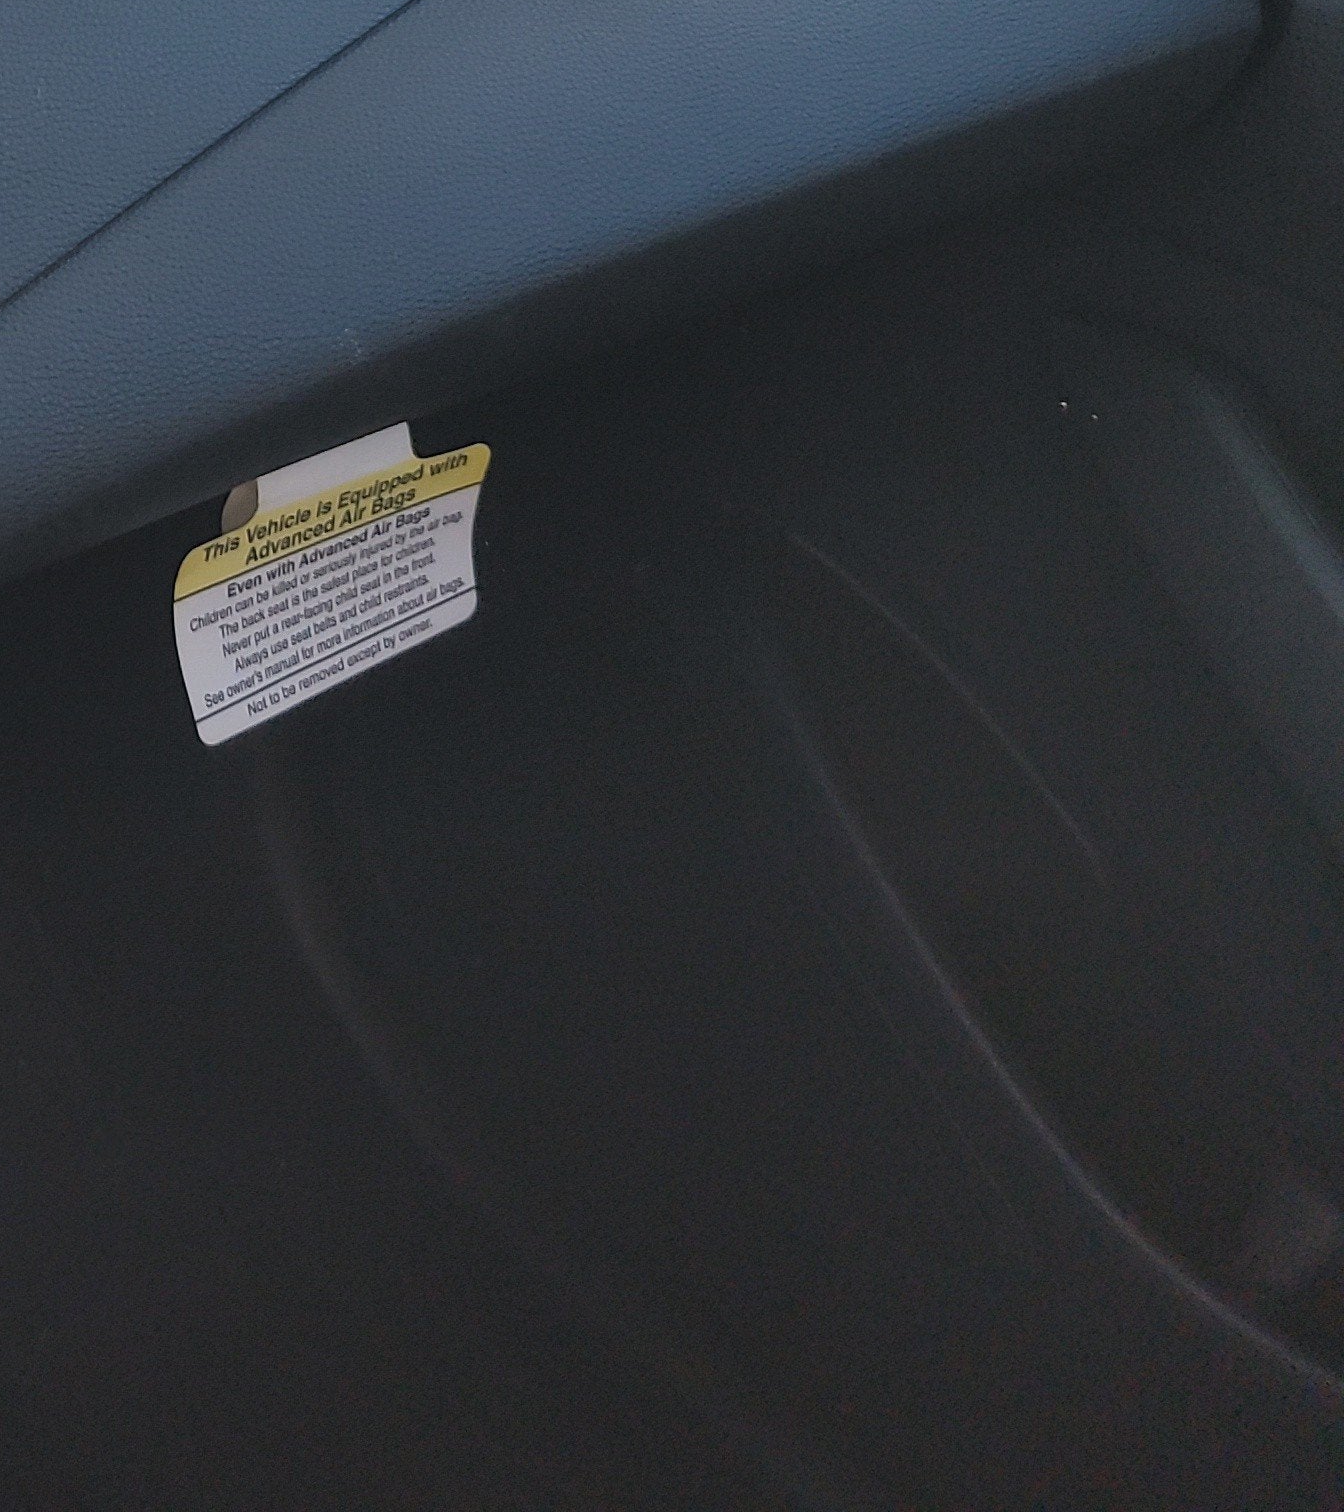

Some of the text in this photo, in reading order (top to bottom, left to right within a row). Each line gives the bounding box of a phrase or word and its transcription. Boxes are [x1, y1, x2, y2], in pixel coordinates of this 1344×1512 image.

[204, 537, 240, 562] This
[247, 509, 311, 543] Vehicle
[338, 464, 423, 513] Equipped
[430, 454, 467, 476] with
[228, 507, 430, 597] Even with Advanced Air Bags
[246, 489, 415, 565] Advanced Air Bags
[248, 618, 433, 716] Not to be removed except by owner.
